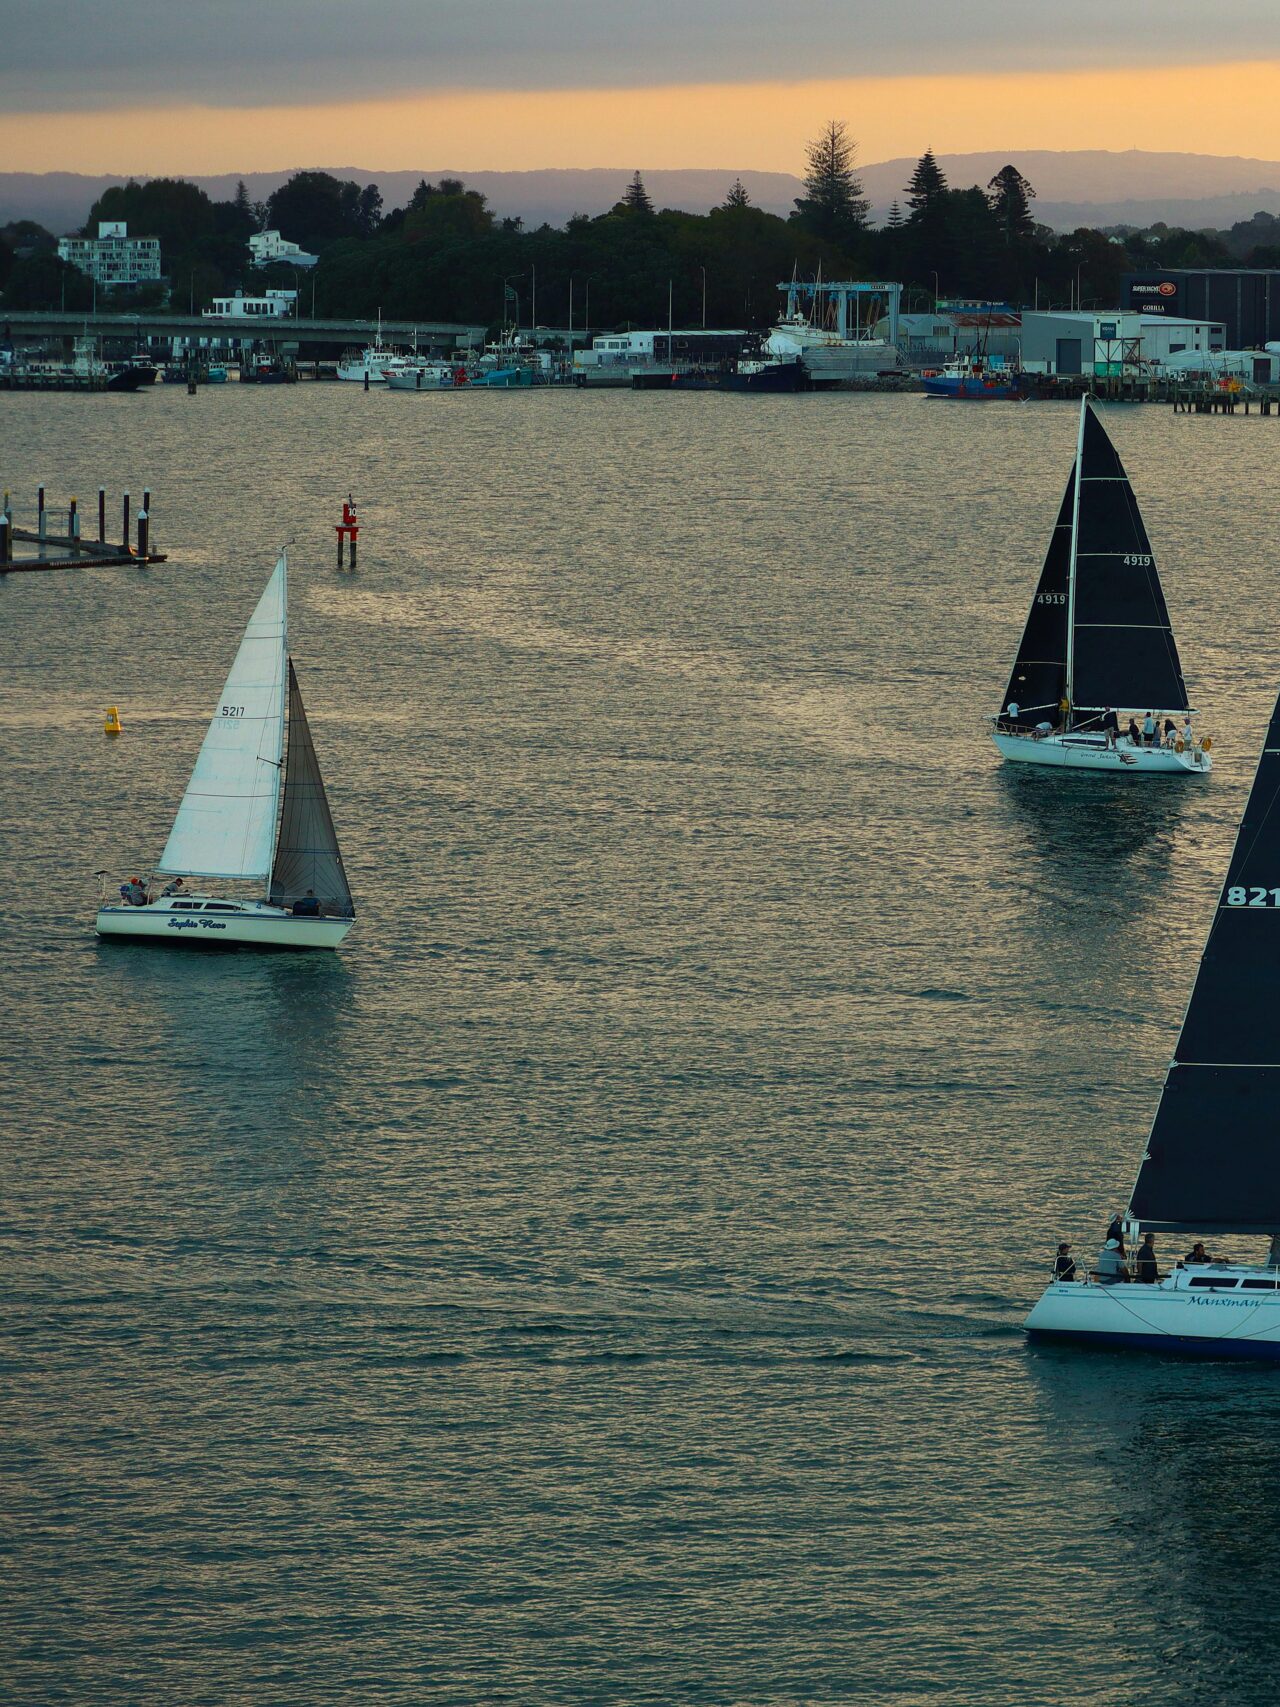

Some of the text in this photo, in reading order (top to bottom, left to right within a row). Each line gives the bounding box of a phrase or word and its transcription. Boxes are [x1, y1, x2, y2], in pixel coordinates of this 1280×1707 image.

[1123, 555, 1151, 566] 4919
[1037, 594, 1066, 604] 4919
[222, 705, 245, 717] 5217
[168, 917, 198, 930] Sophie
[1186, 1295, 1260, 1307] Manxman
